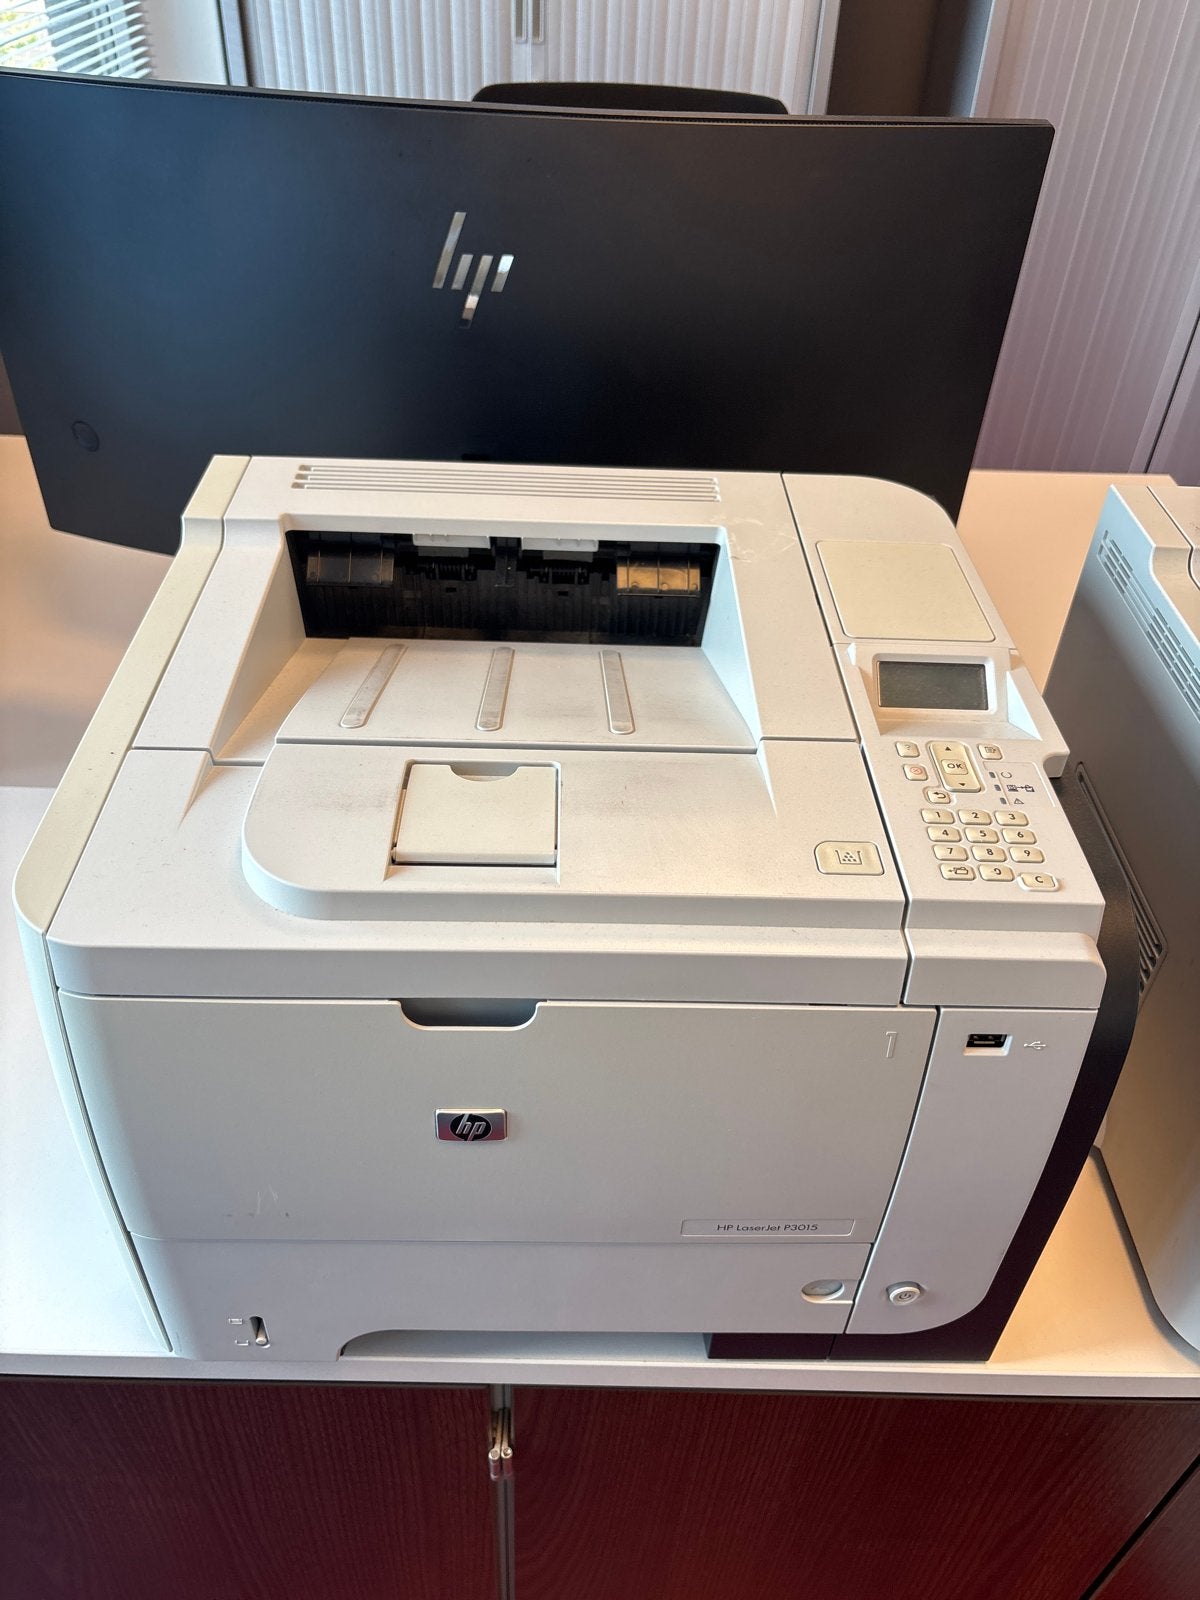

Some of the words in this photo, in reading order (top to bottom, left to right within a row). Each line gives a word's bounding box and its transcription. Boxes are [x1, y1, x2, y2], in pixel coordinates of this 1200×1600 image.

[432, 211, 514, 328] hp
[947, 762, 963, 770] OK
[971, 811, 980, 819] 2
[942, 829, 949, 837] 4
[979, 830, 987, 838] 5
[946, 847, 953, 855] 7
[986, 848, 994, 856] 8
[1023, 849, 1031, 857] 9
[1034, 875, 1044, 884] C
[456, 1113, 487, 1141] hp
[716, 1224, 734, 1232] HP
[736, 1224, 781, 1232] LaserJet
[783, 1223, 819, 1232] P3015
